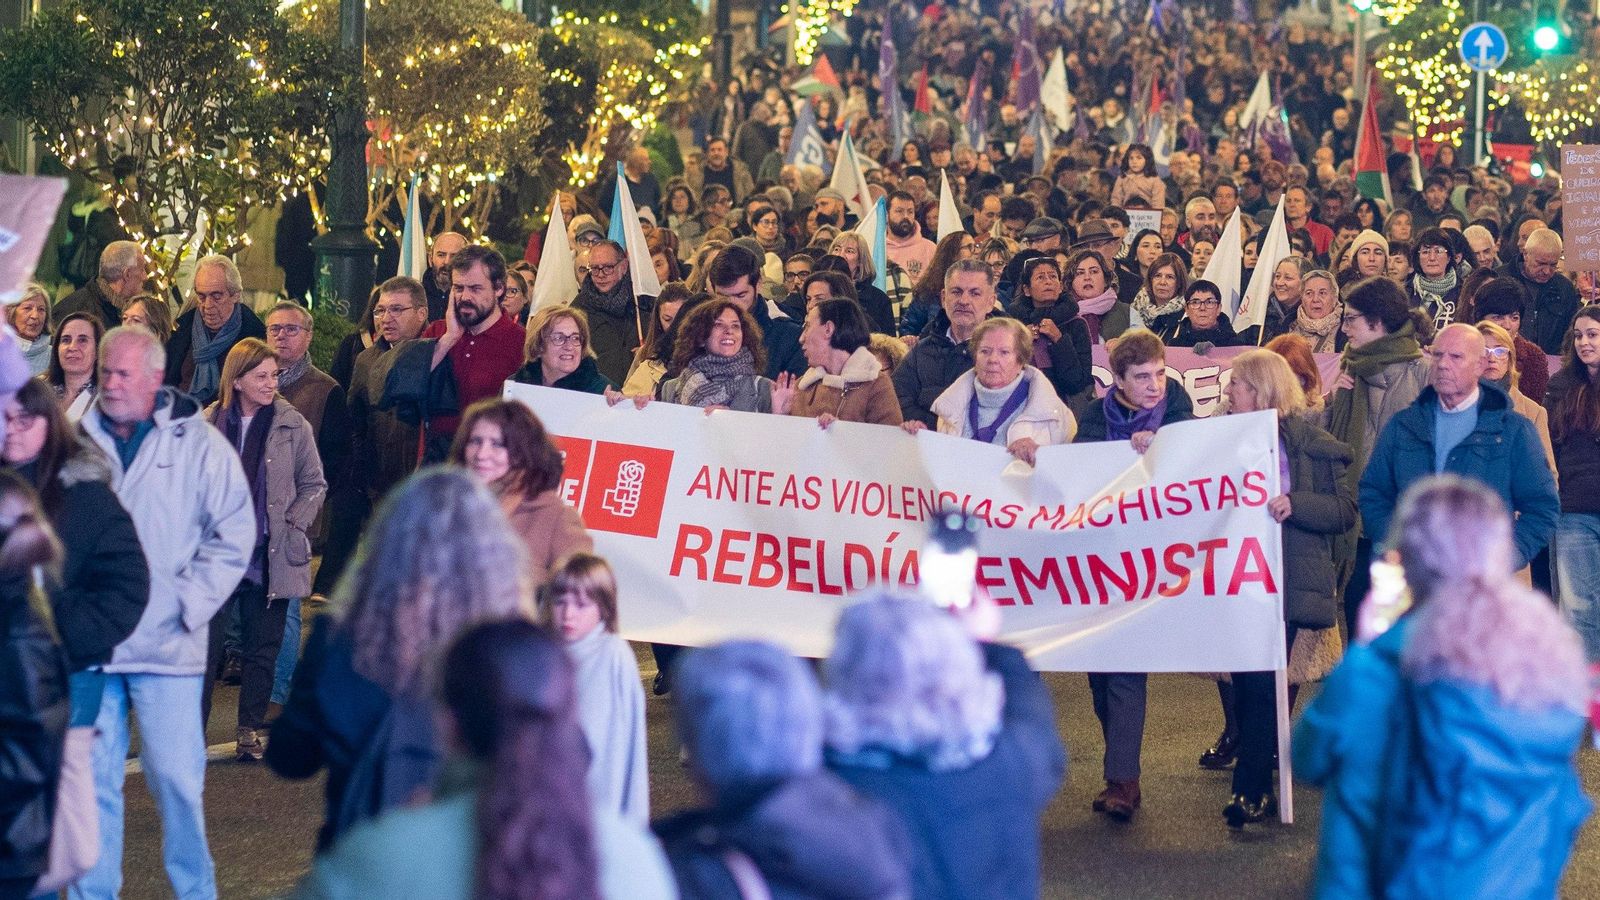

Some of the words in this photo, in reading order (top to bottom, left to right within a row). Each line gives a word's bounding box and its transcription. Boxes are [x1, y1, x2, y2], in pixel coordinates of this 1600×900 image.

[686, 465, 775, 506] ANTE
[779, 474, 822, 511] AS
[832, 479, 1024, 529] VIOLENCIAS
[1028, 470, 1269, 530] MACHISTAS
[669, 523, 921, 597] REBELDÍA
[976, 537, 1278, 606] EMINISTA
